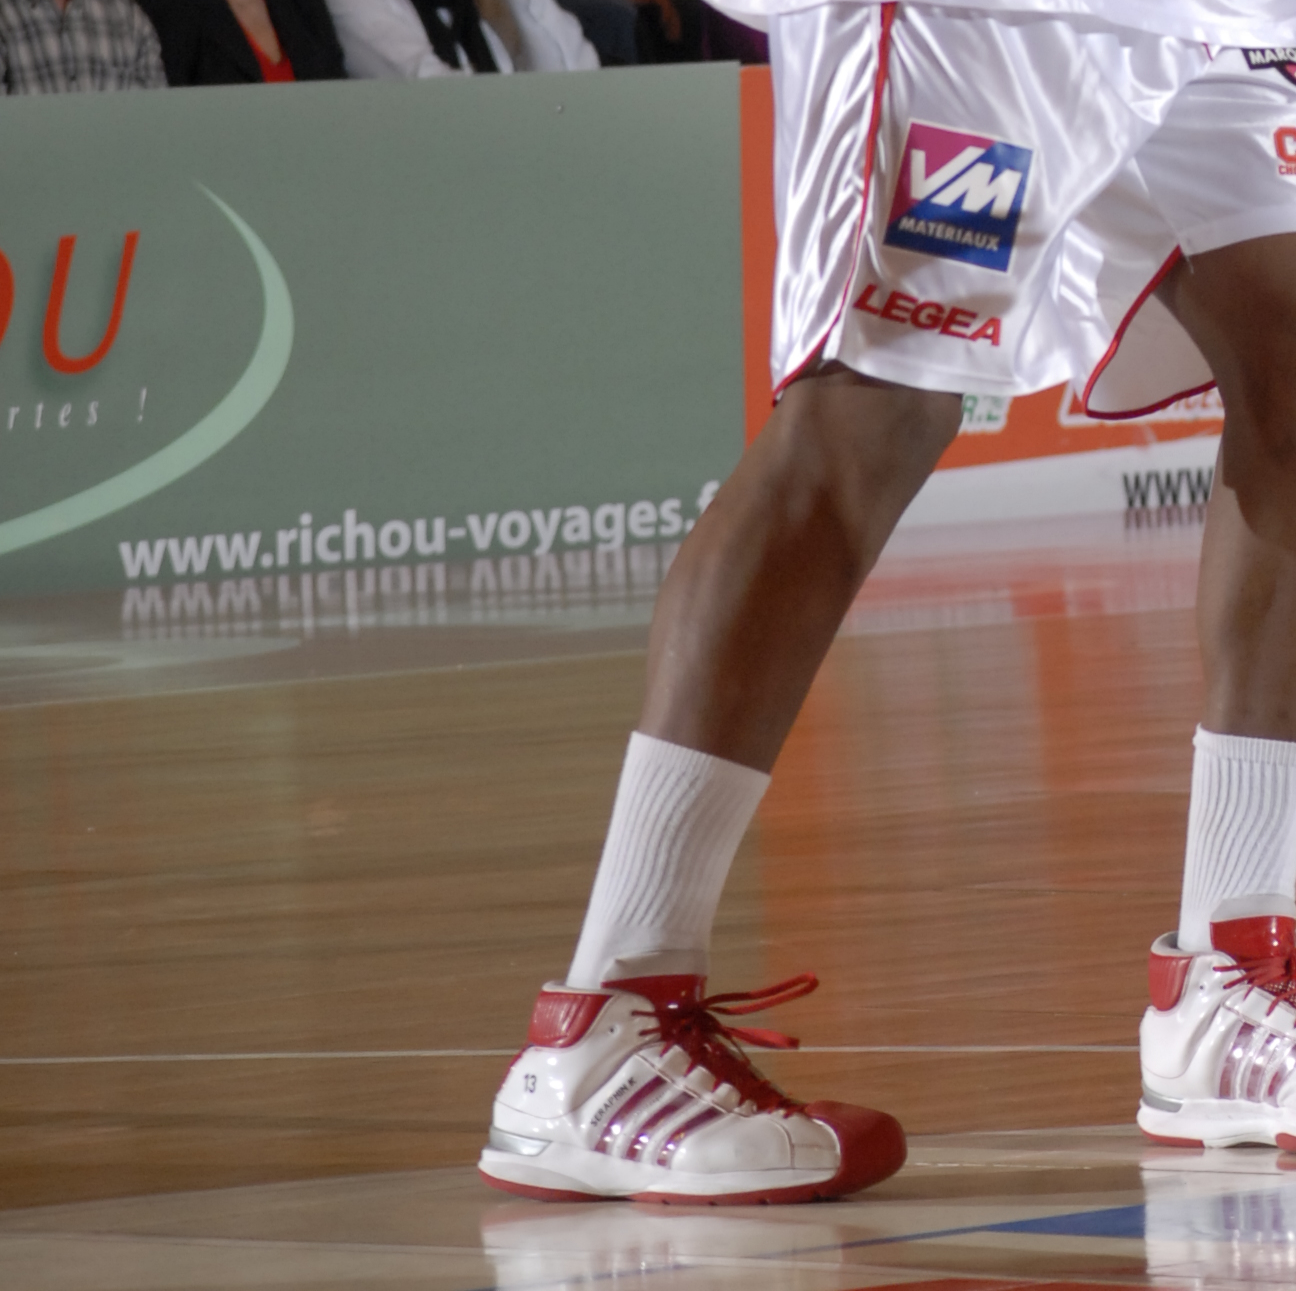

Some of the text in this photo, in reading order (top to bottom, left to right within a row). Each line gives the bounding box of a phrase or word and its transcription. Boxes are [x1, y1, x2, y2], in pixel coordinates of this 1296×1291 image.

[910, 145, 1023, 219] VM
[0, 230, 141, 375] U
[852, 283, 1002, 348] LEGEA
[523, 1073, 537, 1093] 13
